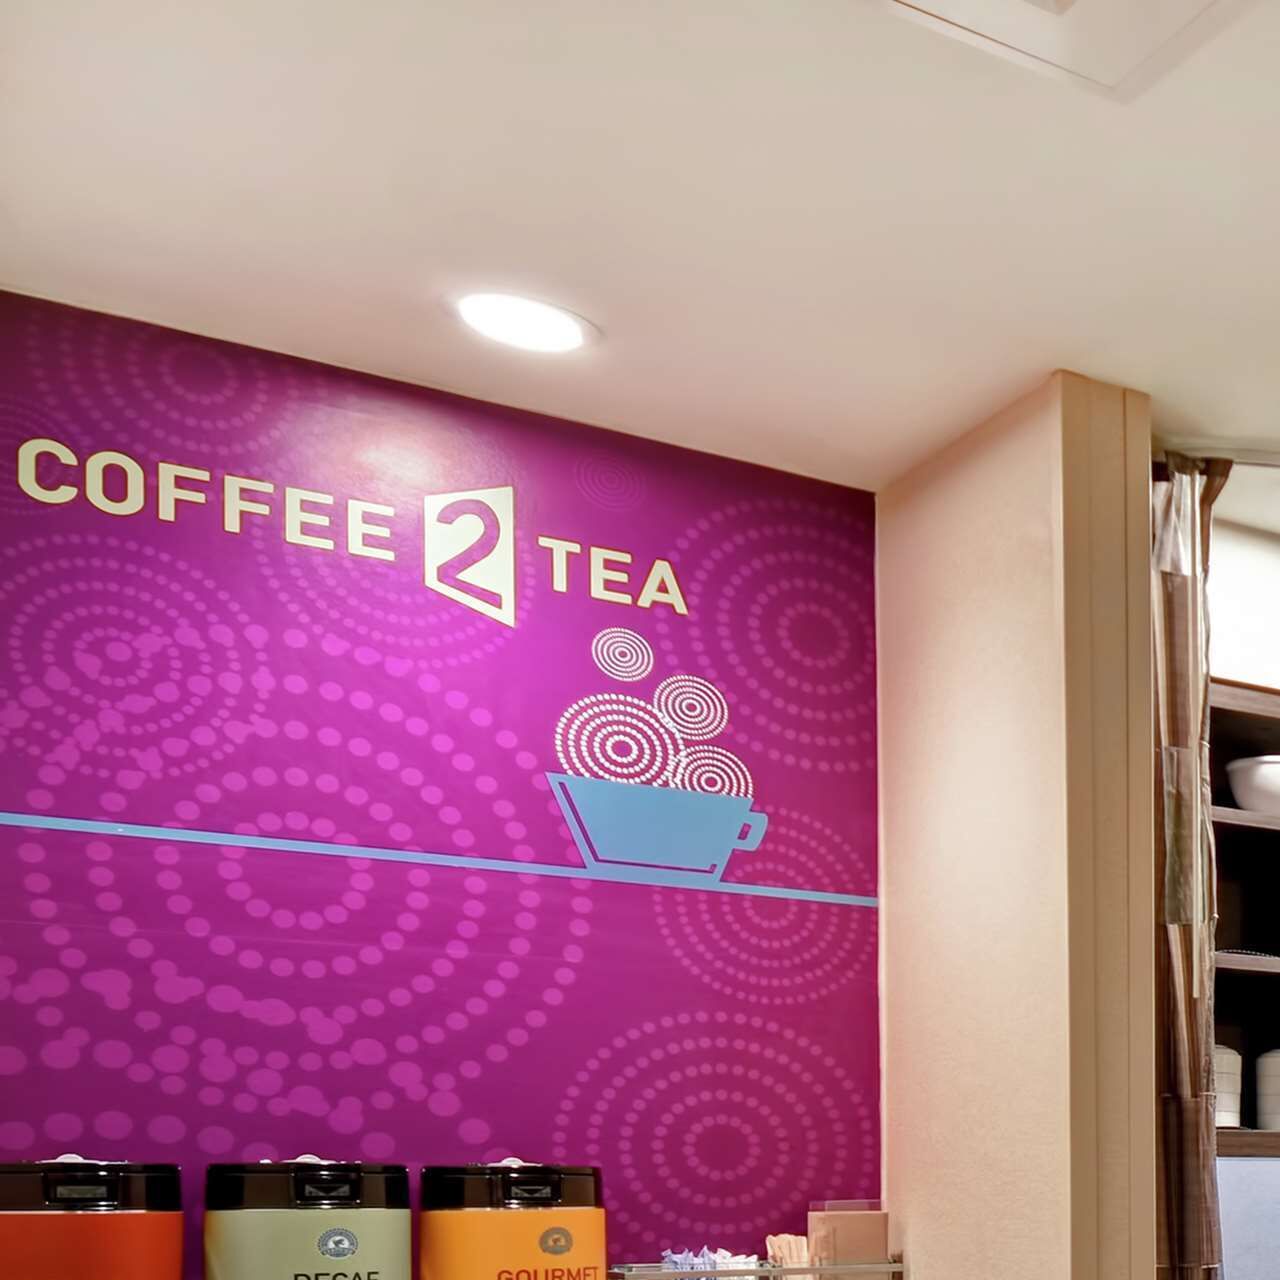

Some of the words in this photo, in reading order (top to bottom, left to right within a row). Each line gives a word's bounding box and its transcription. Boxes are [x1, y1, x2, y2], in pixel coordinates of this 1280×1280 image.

[16, 437, 397, 562] COFFEE
[432, 493, 507, 615] 2
[537, 534, 690, 616] TEA
